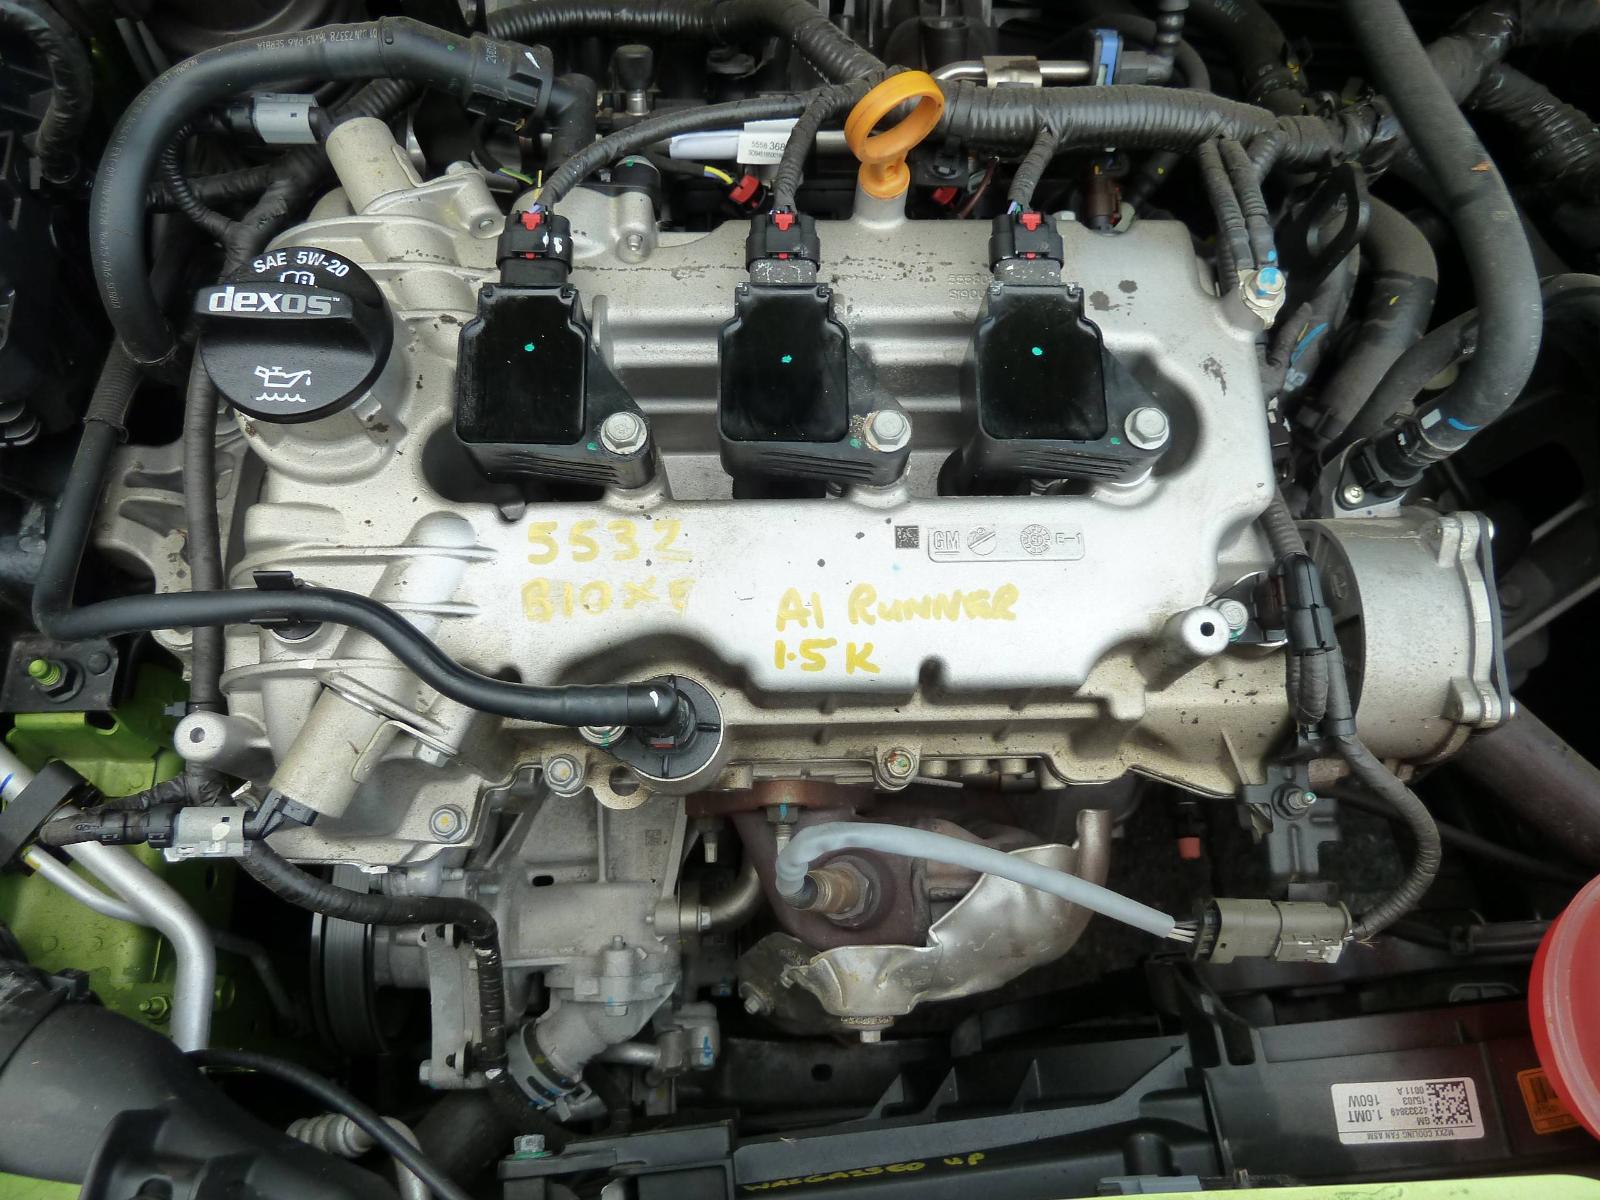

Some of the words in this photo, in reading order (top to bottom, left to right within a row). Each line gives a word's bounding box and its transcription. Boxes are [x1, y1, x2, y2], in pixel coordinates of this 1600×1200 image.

[253, 252, 288, 273] SAE
[296, 251, 350, 278] 5W-20
[208, 286, 332, 315] dexos
[527, 518, 694, 565] 5532
[933, 530, 960, 551] GM
[1348, 1094, 1380, 1107] 160W
[1348, 1109, 1383, 1123] 1.0MT
[1417, 1117, 1430, 1125] GM
[1402, 1130, 1433, 1139] COOLING
